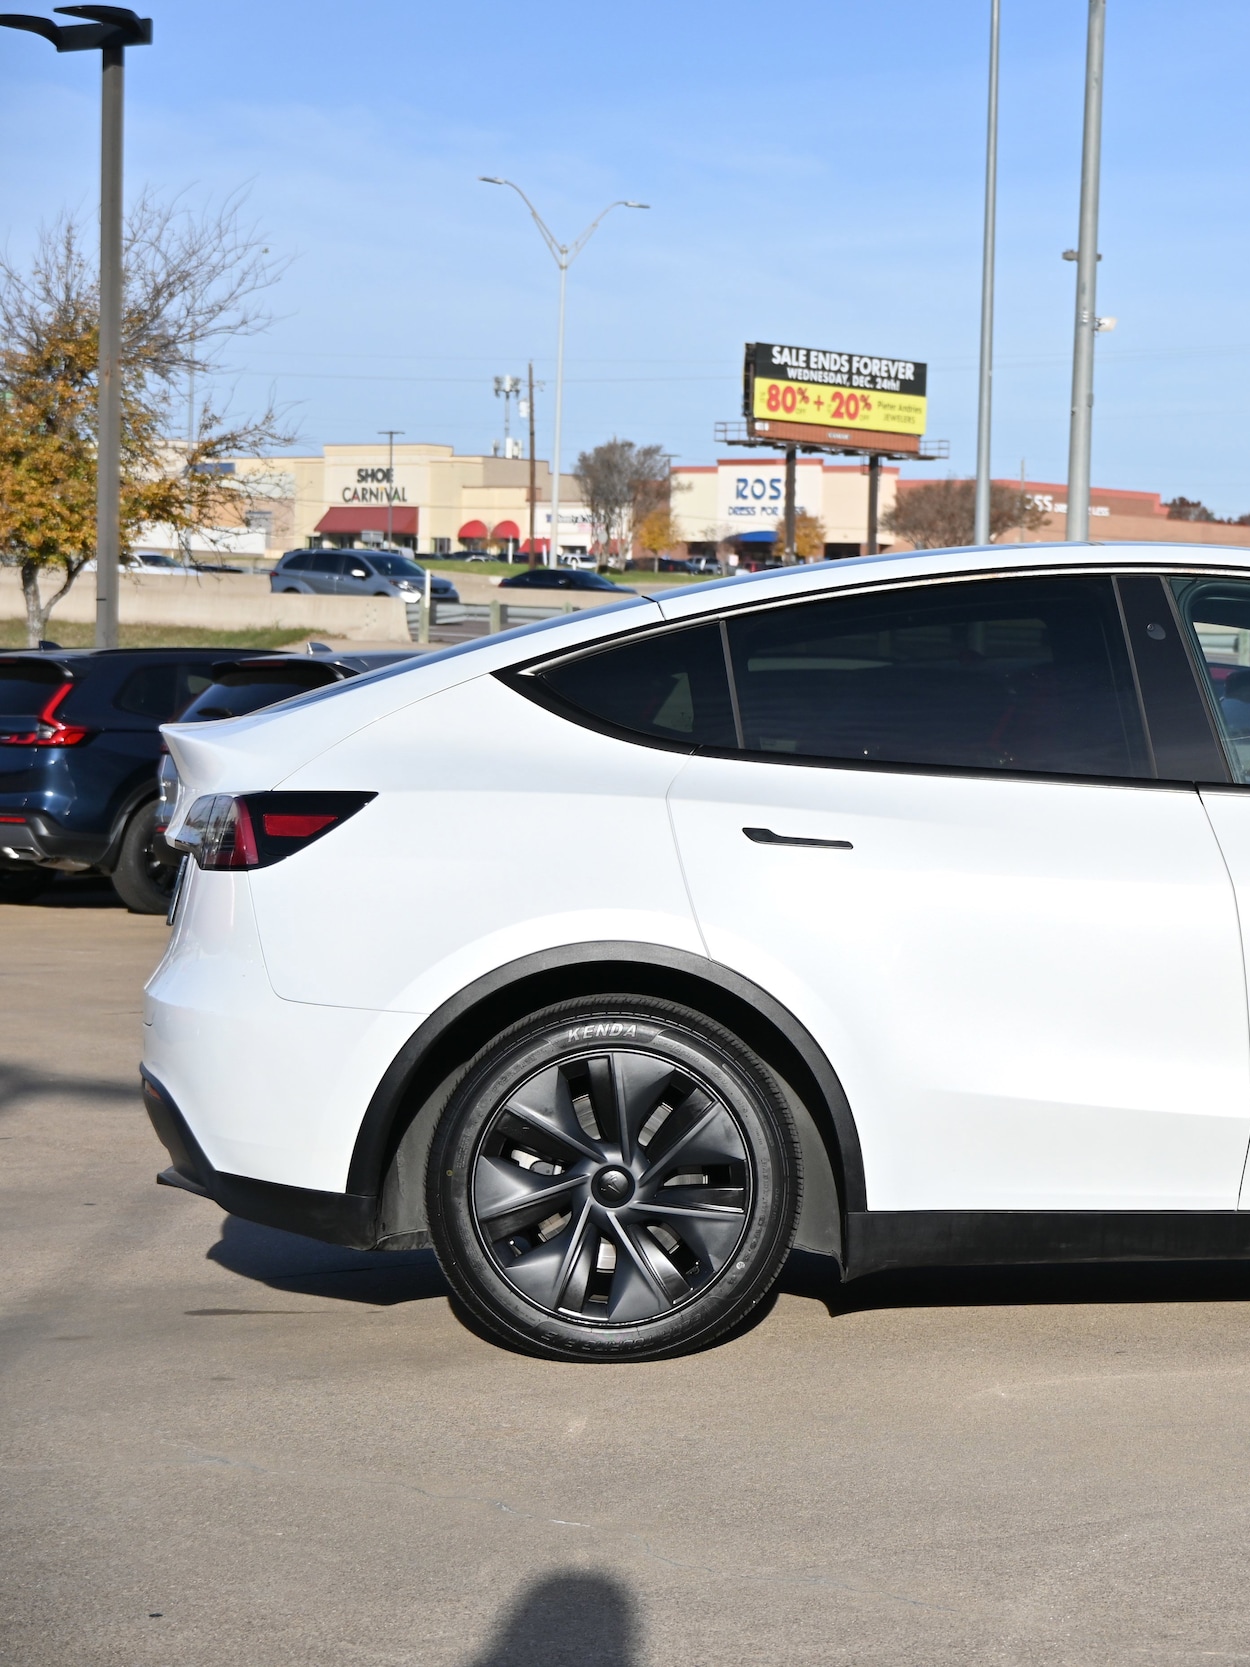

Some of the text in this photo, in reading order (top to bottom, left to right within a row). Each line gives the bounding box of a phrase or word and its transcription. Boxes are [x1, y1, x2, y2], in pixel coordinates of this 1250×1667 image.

[771, 346, 914, 381] SALE ENDS FOREVER
[787, 367, 900, 391] WEDNESDAY, DEC. 24th!
[766, 384, 872, 421] 80% + 20%
[356, 467, 394, 483] SHOE
[342, 486, 407, 503] CARNIVAL
[736, 478, 784, 500] ROS
[728, 506, 756, 516] DRESS
[761, 506, 779, 516] FOR
[1024, 494, 1053, 512] OSS
[567, 1022, 638, 1043] KENDA
